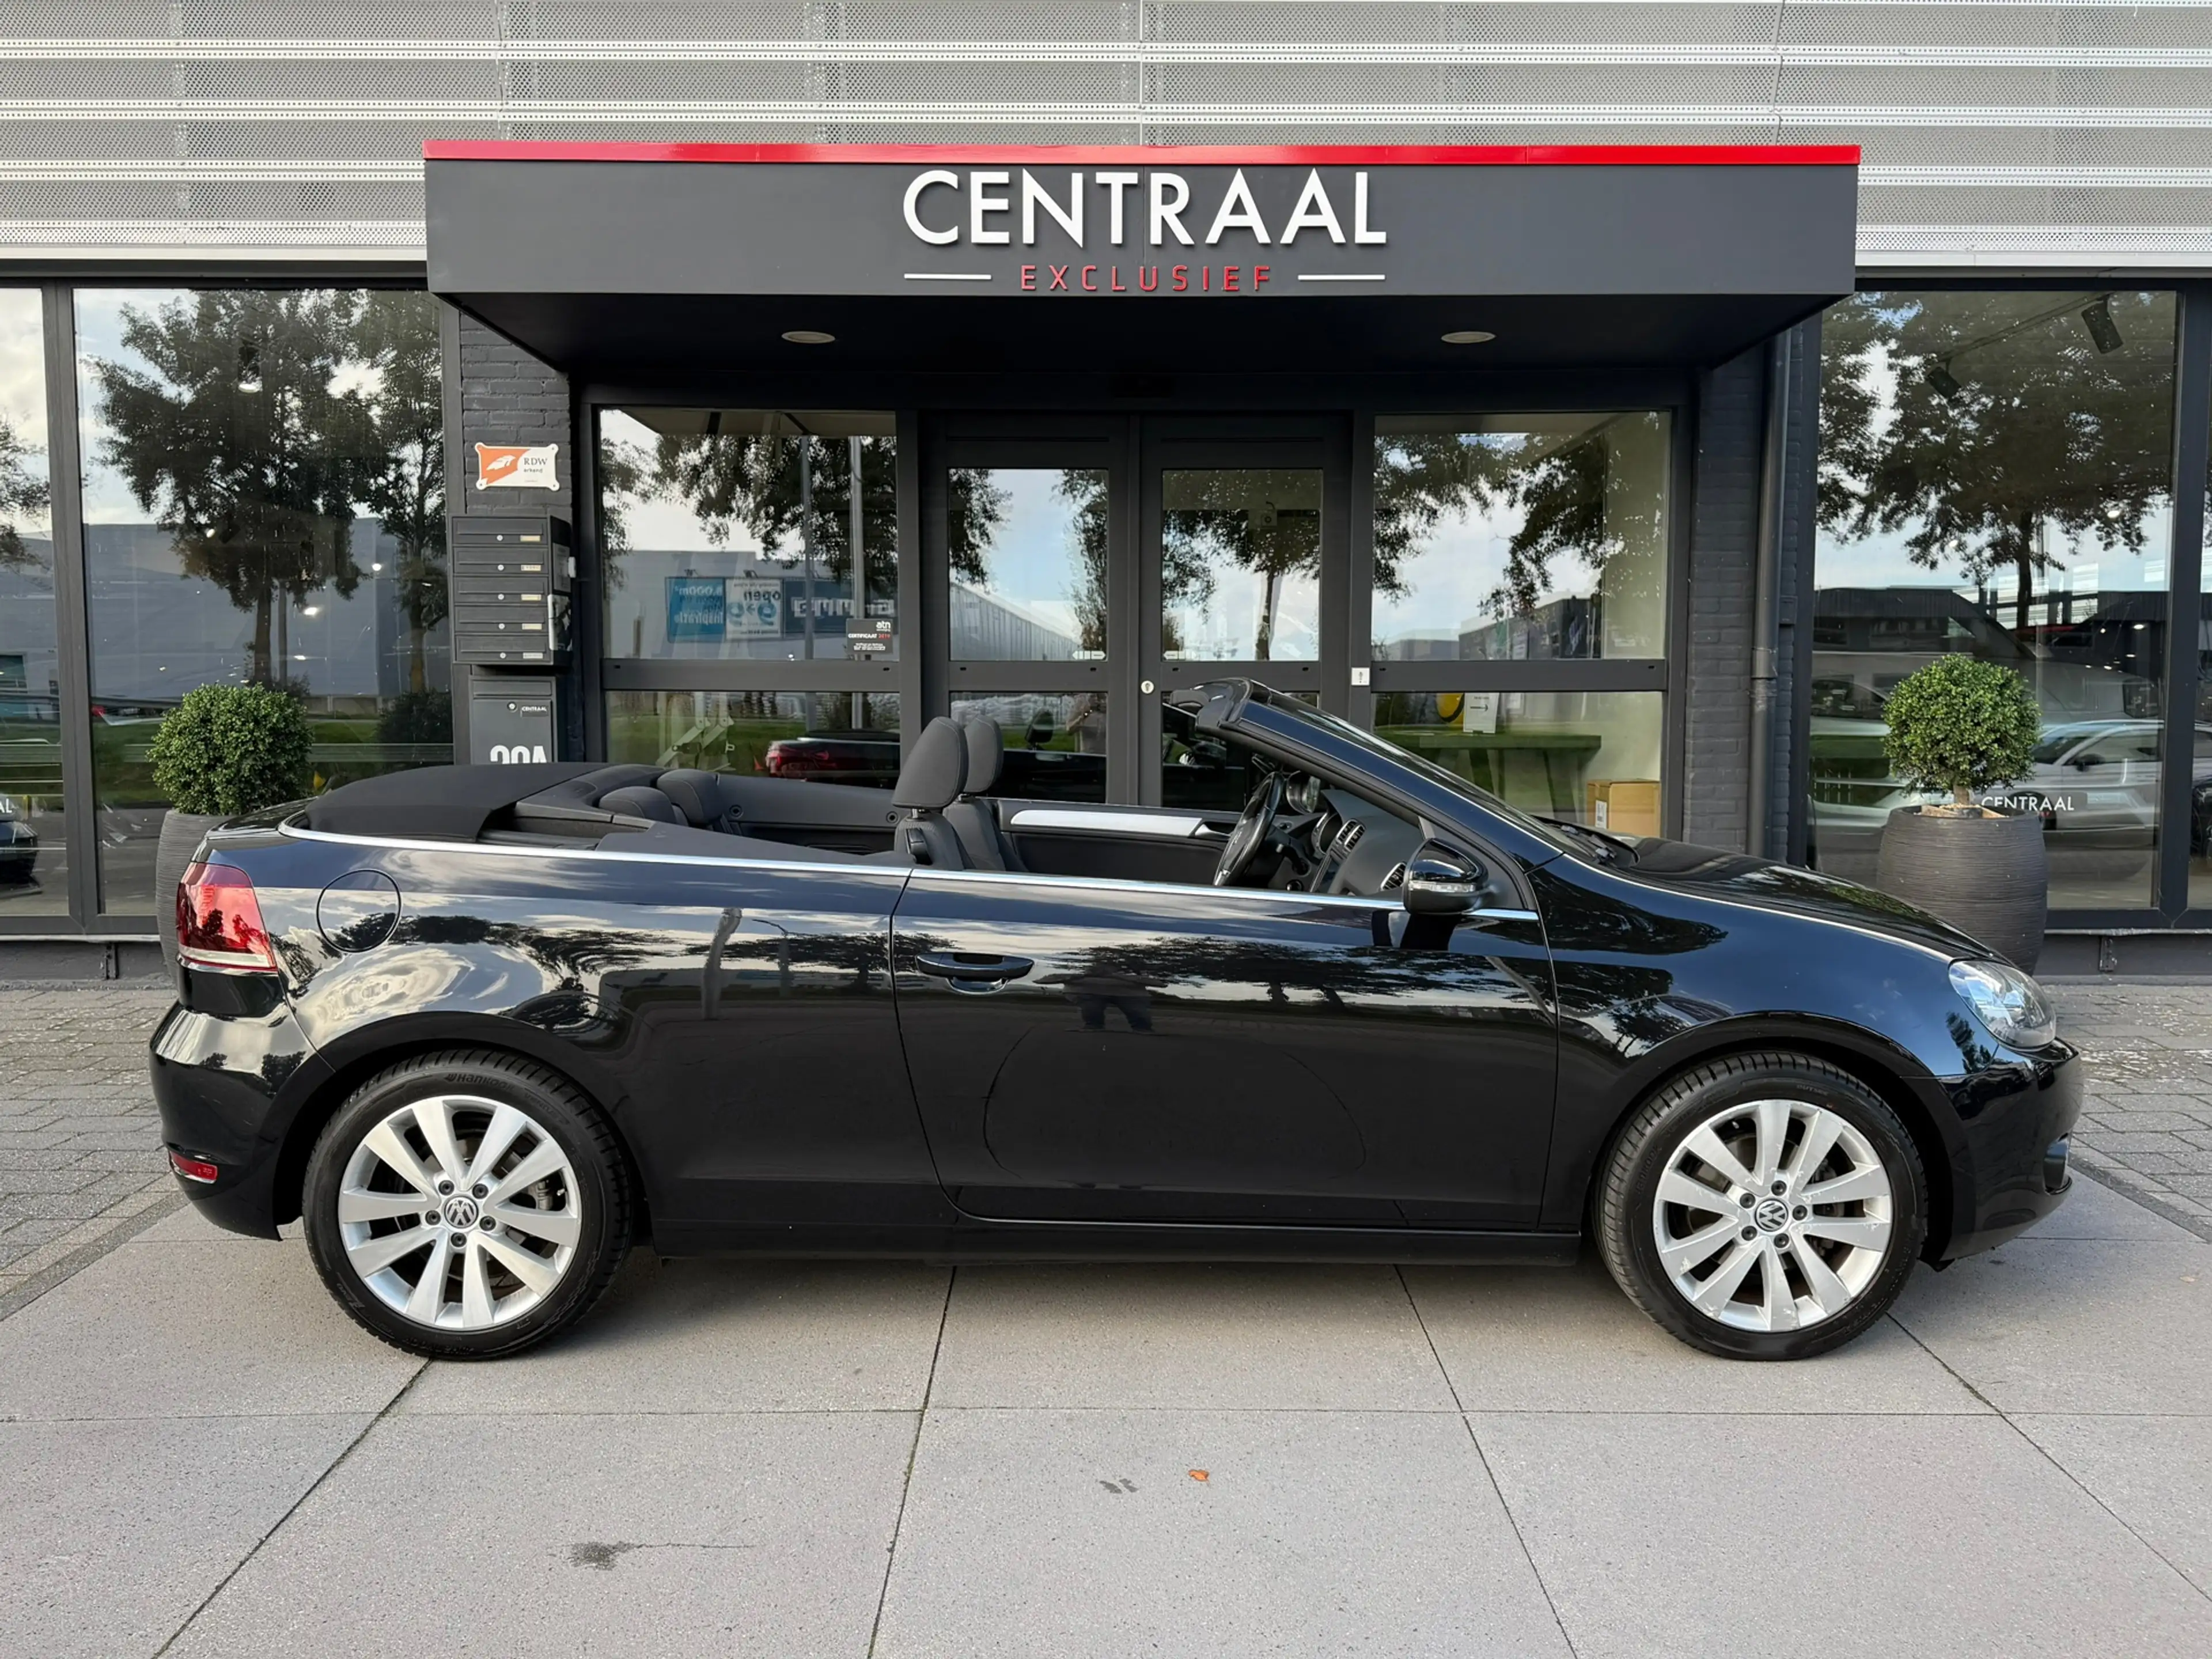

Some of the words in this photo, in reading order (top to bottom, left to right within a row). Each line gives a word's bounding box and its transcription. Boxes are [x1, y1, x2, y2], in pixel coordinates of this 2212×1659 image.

[903, 168, 1387, 248] CENTRAAL
[1020, 265, 1271, 292] EXCLUSIEF
[524, 457, 548, 465] RDW
[1981, 796, 2074, 811] CENTRAAL
